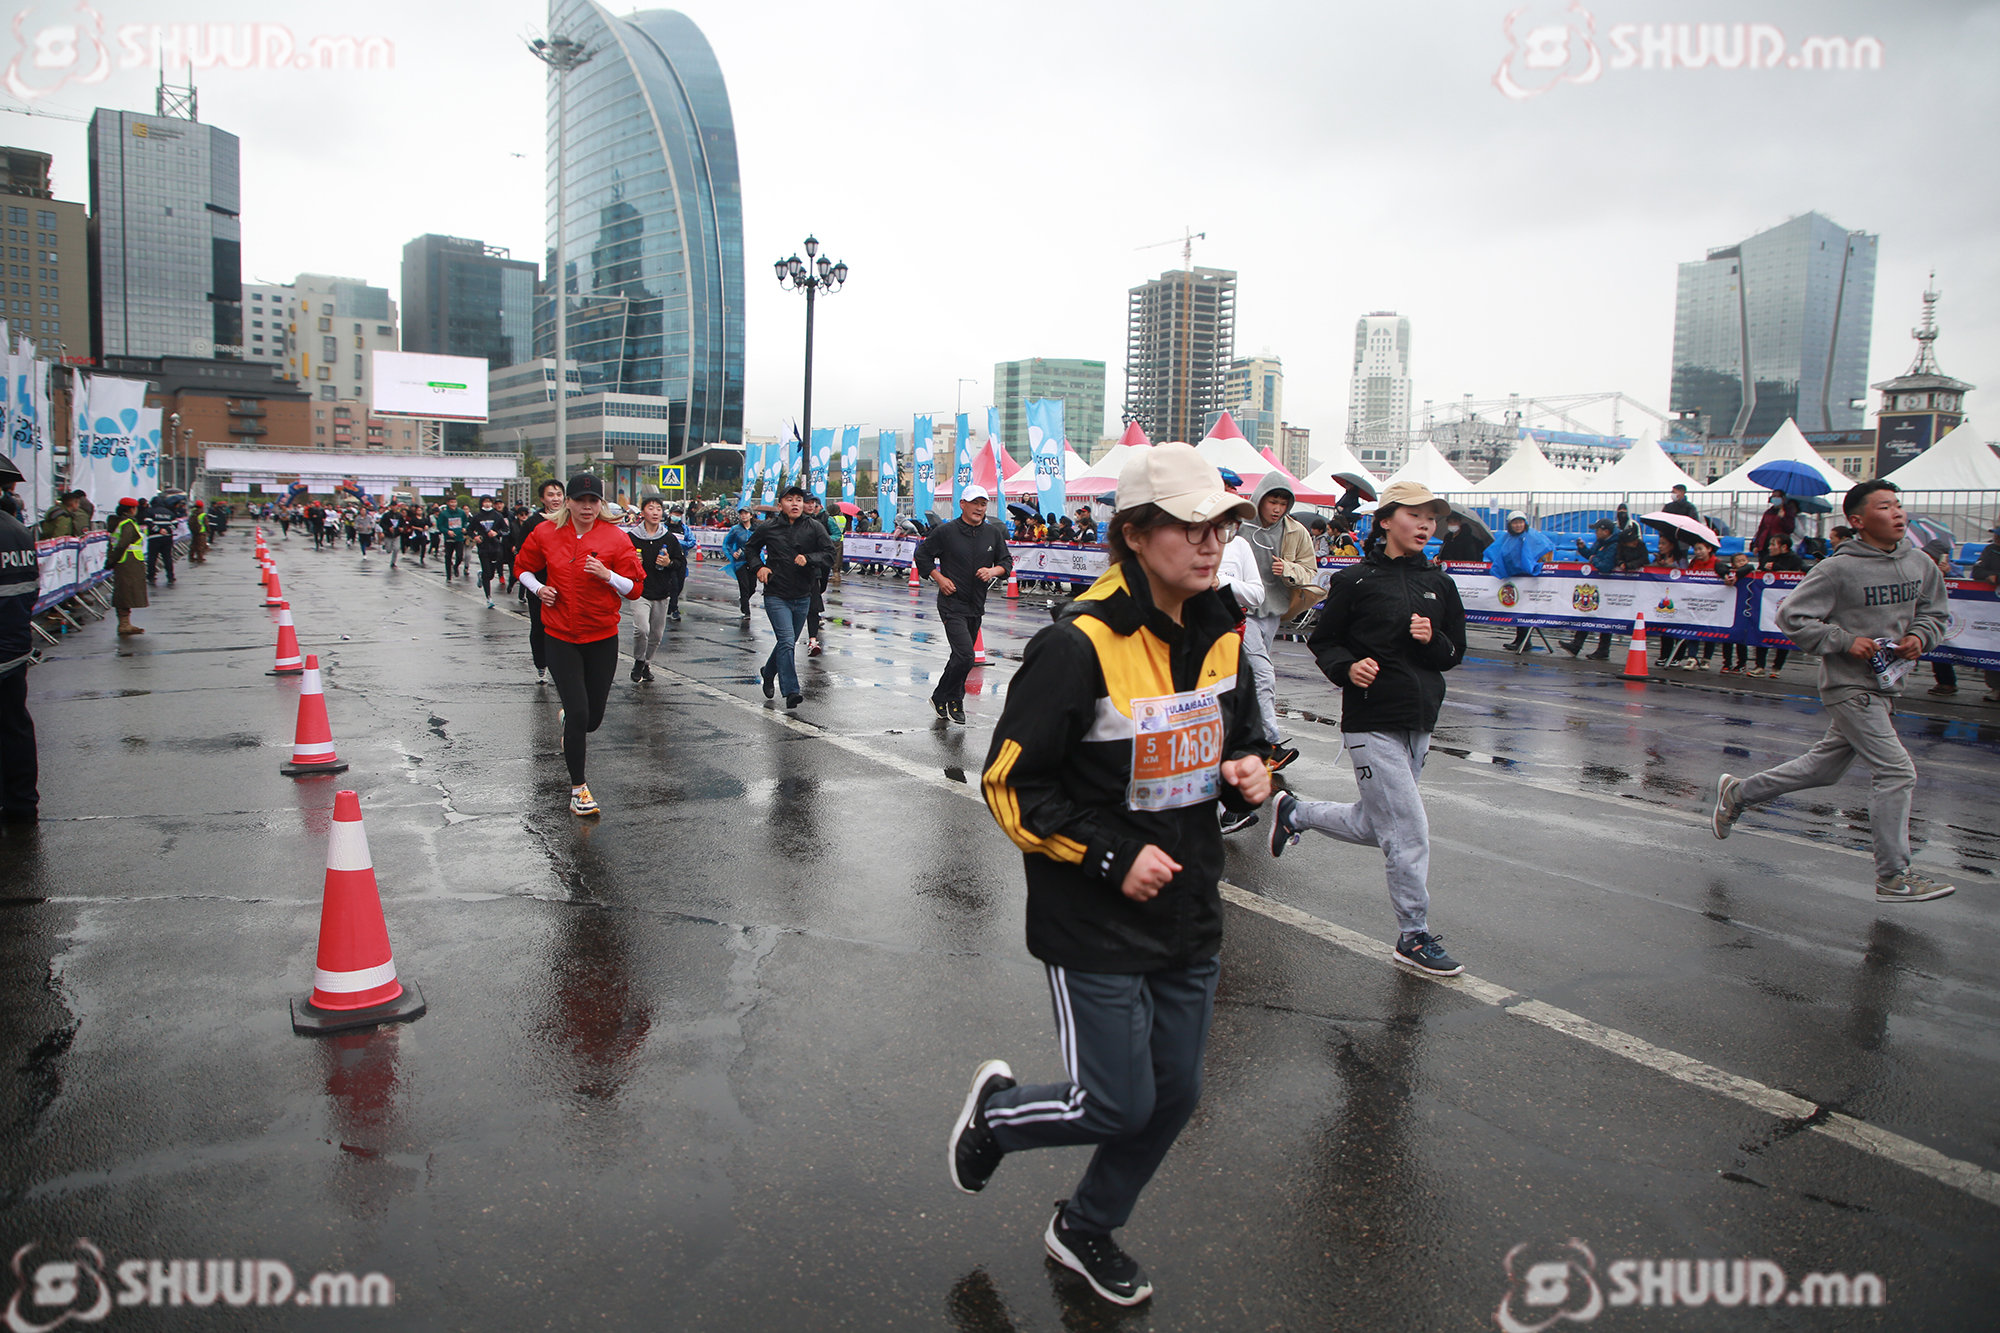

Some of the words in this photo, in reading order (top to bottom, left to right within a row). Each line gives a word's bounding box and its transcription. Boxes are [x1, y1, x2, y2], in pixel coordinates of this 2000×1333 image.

[93, 433, 119, 447] bon
[90, 446, 127, 458] aqua
[1, 550, 36, 569] POLIC
[1146, 738, 1157, 753] 5
[1167, 723, 1220, 771] 14584
[1143, 755, 1159, 764] KM
